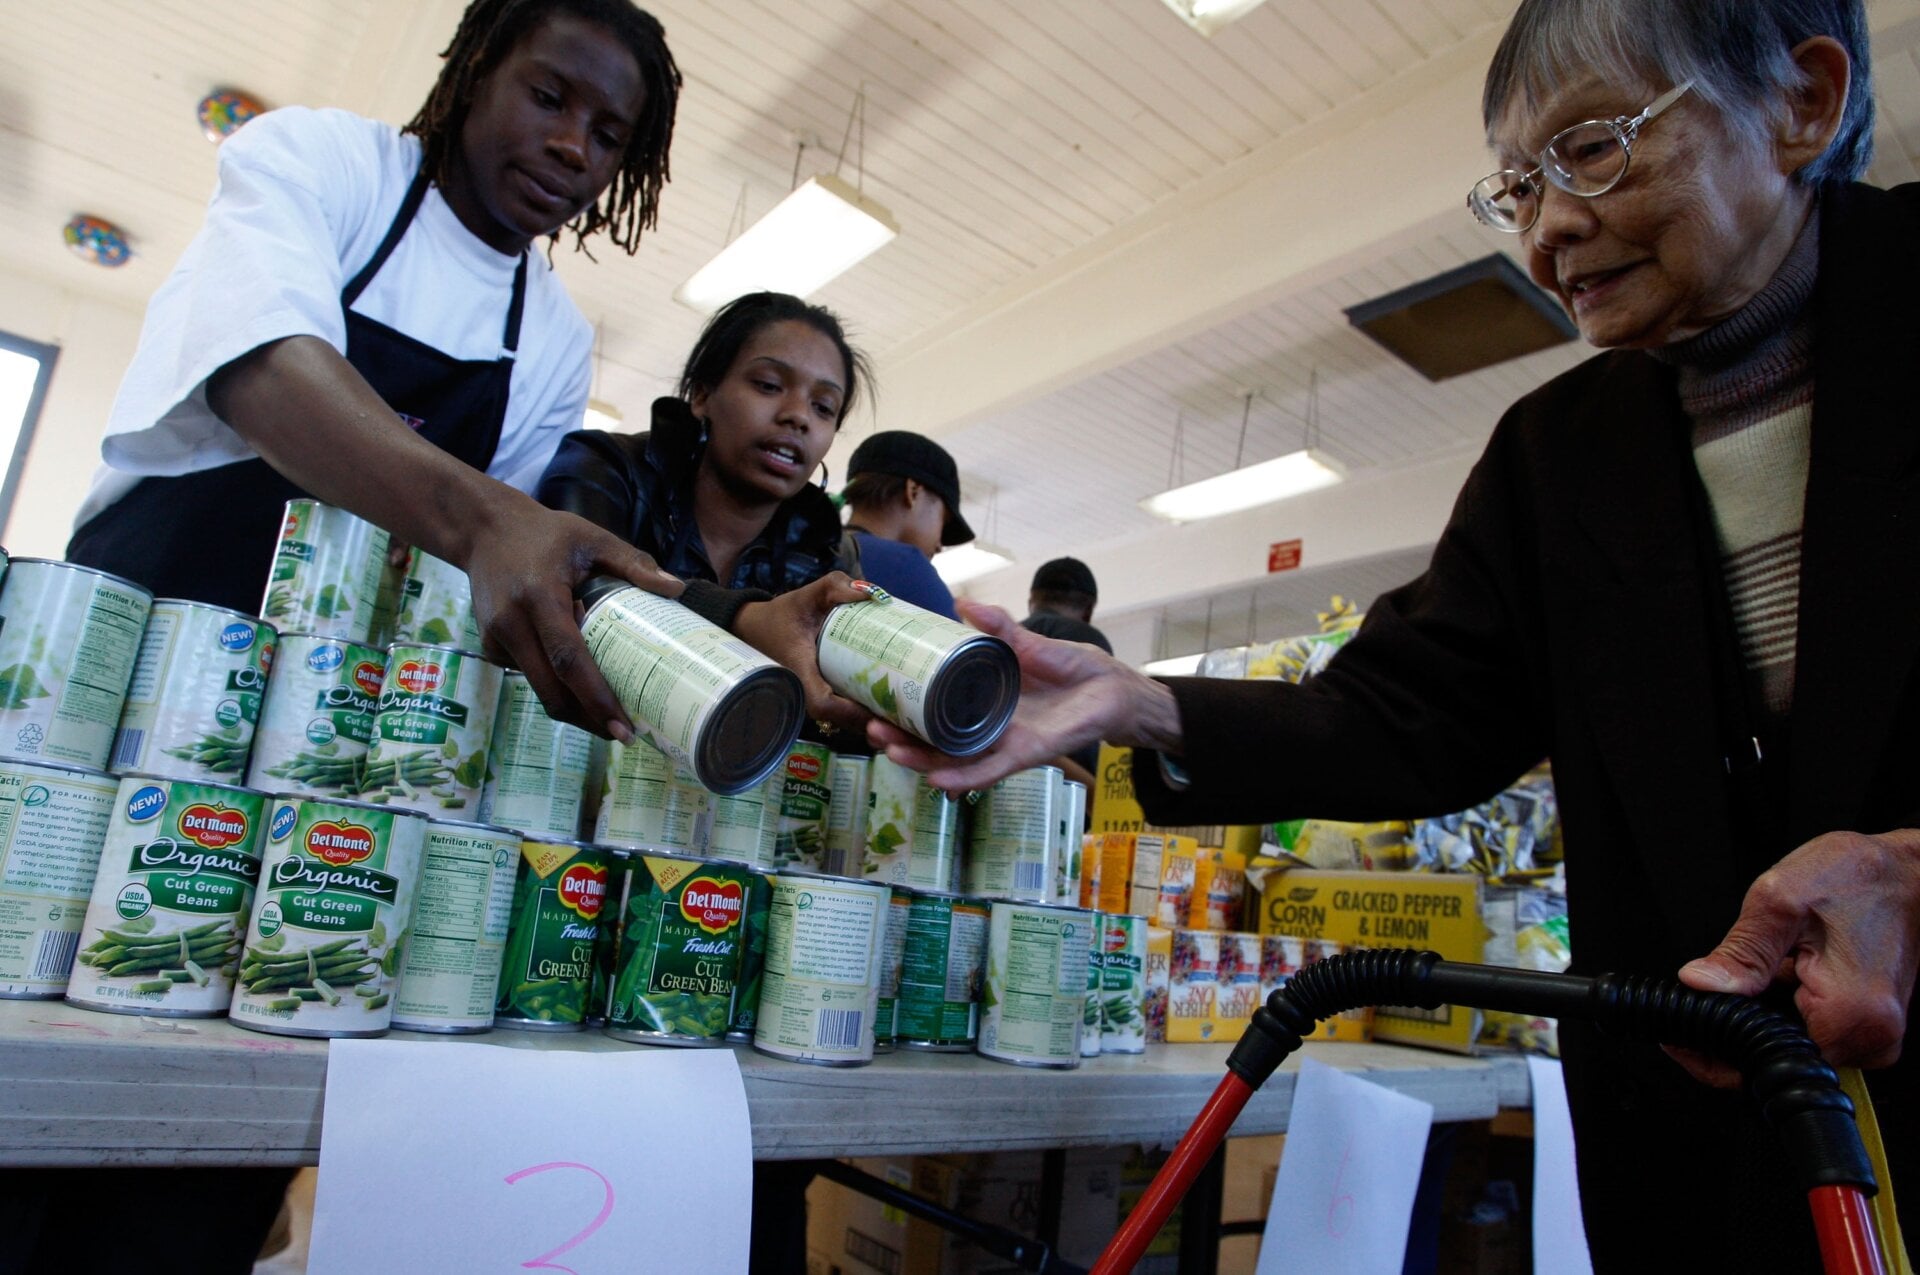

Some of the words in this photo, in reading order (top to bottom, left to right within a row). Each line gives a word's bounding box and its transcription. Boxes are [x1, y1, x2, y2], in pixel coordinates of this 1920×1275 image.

[95, 587, 129, 605] Nutrition
[221, 629, 252, 643] NEW!
[309, 650, 342, 666] NEW!
[358, 669, 370, 680] Del
[400, 669, 414, 679] Del
[413, 670, 441, 682] Monte
[326, 684, 379, 716] Orga
[380, 687, 463, 716] Organic
[344, 715, 360, 726] Cut
[387, 717, 402, 726] Cut
[405, 719, 436, 730] Green
[393, 728, 423, 739] Beans
[1105, 763, 1133, 784] COR
[784, 781, 829, 800] rganic
[1104, 784, 1135, 800] THIN
[129, 792, 163, 815] NEW!
[37, 811, 50, 819] the
[272, 812, 295, 834] NEW!
[21, 820, 45, 829] tasting
[47, 823, 66, 831] green
[185, 814, 206, 830] Del
[207, 818, 244, 835] Monte
[16, 839, 36, 847] USDA
[38, 842, 63, 850] organic
[60, 835, 81, 843] grown
[200, 831, 226, 843] Quality
[310, 832, 330, 846] Del
[331, 835, 370, 851] Monte
[430, 835, 468, 848] Nutrition
[471, 840, 493, 851] Facts
[13, 849, 45, 859] synthetic
[140, 836, 257, 877] Organic
[324, 848, 350, 860] Quality
[20, 860, 37, 868] They
[39, 862, 65, 870] contain
[17, 869, 46, 878] artificial
[276, 854, 393, 895] Organic
[5, 879, 27, 887] suited
[29, 880, 39, 888] for
[54, 884, 66, 892] way
[164, 877, 191, 890] Cut
[195, 881, 234, 895] Green
[564, 876, 586, 894] Del
[783, 885, 796, 894] Facts
[125, 891, 145, 901] USDA
[176, 893, 219, 908] Beans
[293, 895, 316, 908] Cut
[321, 899, 362, 913] Green
[686, 890, 709, 909] Del
[828, 896, 854, 904] HEALTHY
[1332, 889, 1398, 915] CRACKED
[1403, 894, 1462, 918] PEPPER
[120, 902, 146, 911] ORGANIC
[263, 909, 277, 919] USDA
[1268, 897, 1326, 928] CORN
[303, 911, 346, 925] Beans
[542, 911, 576, 923] MADE
[703, 909, 728, 923] Quality
[1013, 913, 1039, 924] Nutrition
[1042, 916, 1059, 926] Facts
[560, 922, 588, 939] Fresh
[587, 928, 599, 940] Cu
[664, 925, 698, 937] MADE
[1358, 916, 1369, 937] &
[1375, 917, 1429, 941] LEMON
[682, 937, 714, 953] Fresh
[713, 940, 735, 955] Cut
[538, 959, 583, 978] GREEN
[695, 960, 724, 978] CUT
[660, 972, 708, 993] GREEN
[1326, 1130, 1355, 1240] 6
[502, 1161, 615, 1275] 2
